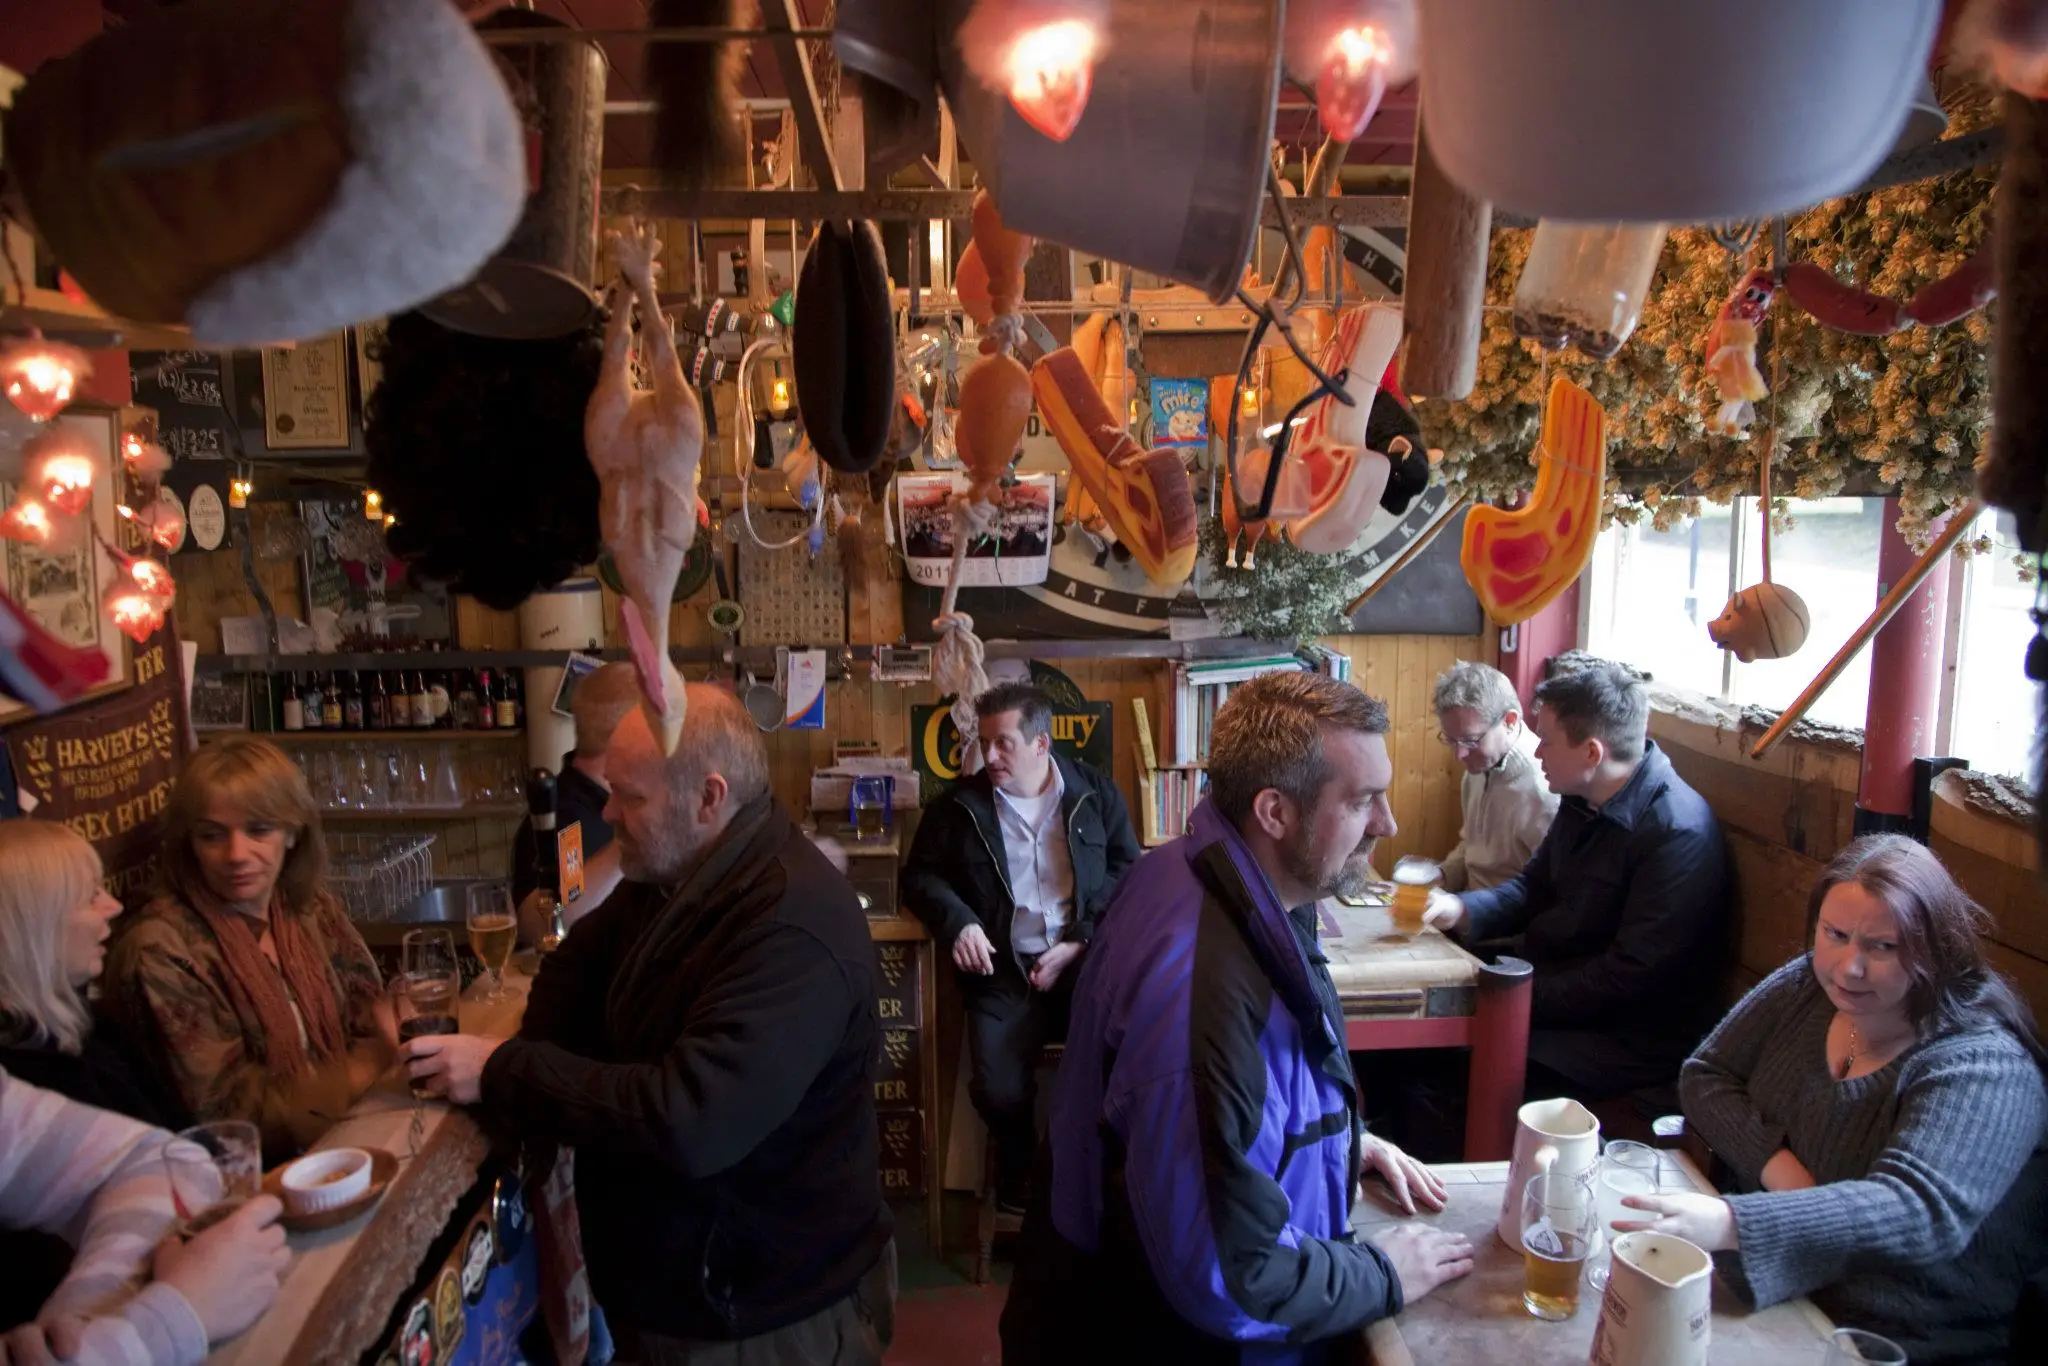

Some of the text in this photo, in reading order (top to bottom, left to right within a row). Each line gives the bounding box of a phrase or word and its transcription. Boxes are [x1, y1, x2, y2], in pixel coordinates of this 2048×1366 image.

[134, 645, 165, 683] TER
[56, 722, 149, 767] HARVEY'S
[66, 810, 113, 841] SEX
[879, 998, 903, 1017] ER
[873, 1080, 908, 1101] TER
[879, 1169, 910, 1187] ER
